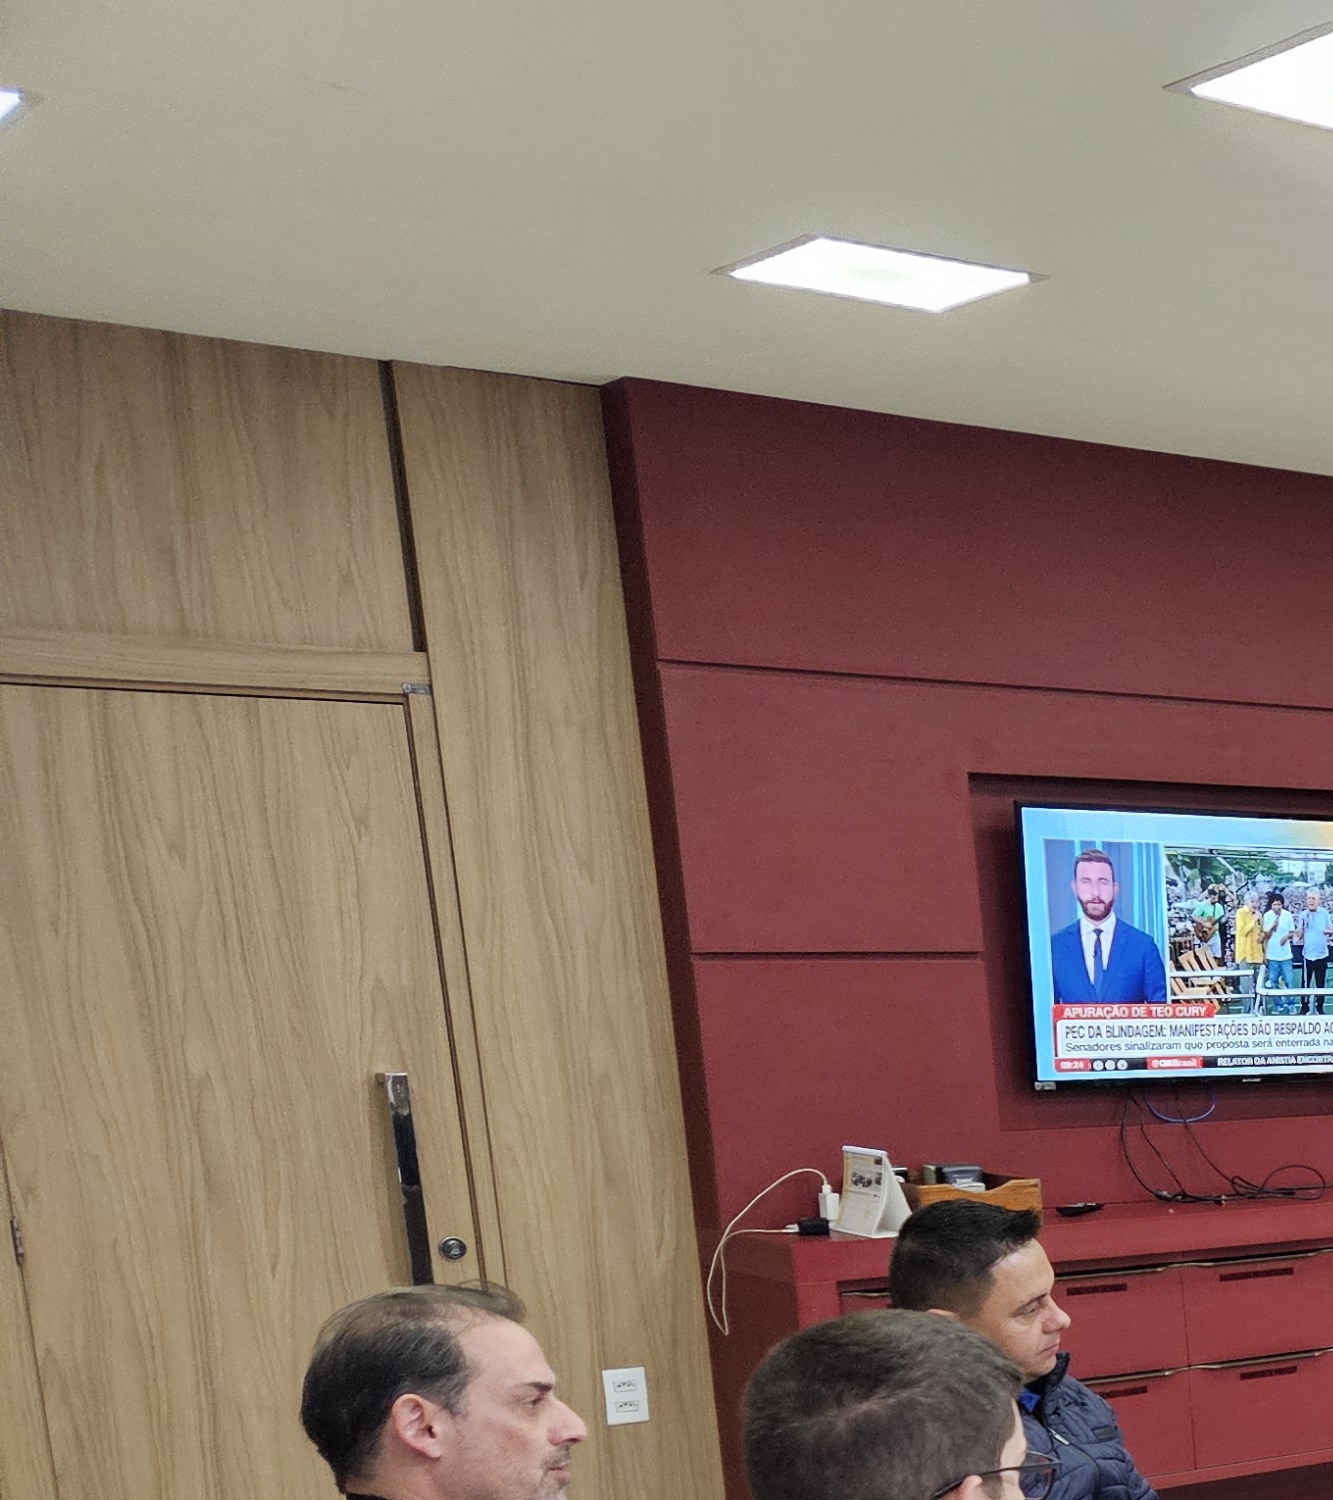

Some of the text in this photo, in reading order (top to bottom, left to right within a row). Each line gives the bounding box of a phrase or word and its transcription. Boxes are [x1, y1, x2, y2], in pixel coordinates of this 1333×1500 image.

[1063, 1004, 1207, 1019] APURAÇÃO DE TEO CURY
[1065, 1026, 1086, 1039] PEC
[1088, 1026, 1102, 1039] DA
[1106, 1025, 1166, 1038] BLINDAGEM:
[1170, 1020, 1249, 1039] MANIFESTAÇÕES
[1252, 1019, 1271, 1036] DÃO
[1274, 1021, 1322, 1036] RESPALDO
[1066, 1041, 1122, 1052] Senadores
[1124, 1040, 1182, 1050] sinalizaram
[1184, 1042, 1203, 1051] que
[1206, 1040, 1249, 1050] proposta
[1252, 1040, 1272, 1048] será
[1275, 1038, 1320, 1047] enterrada
